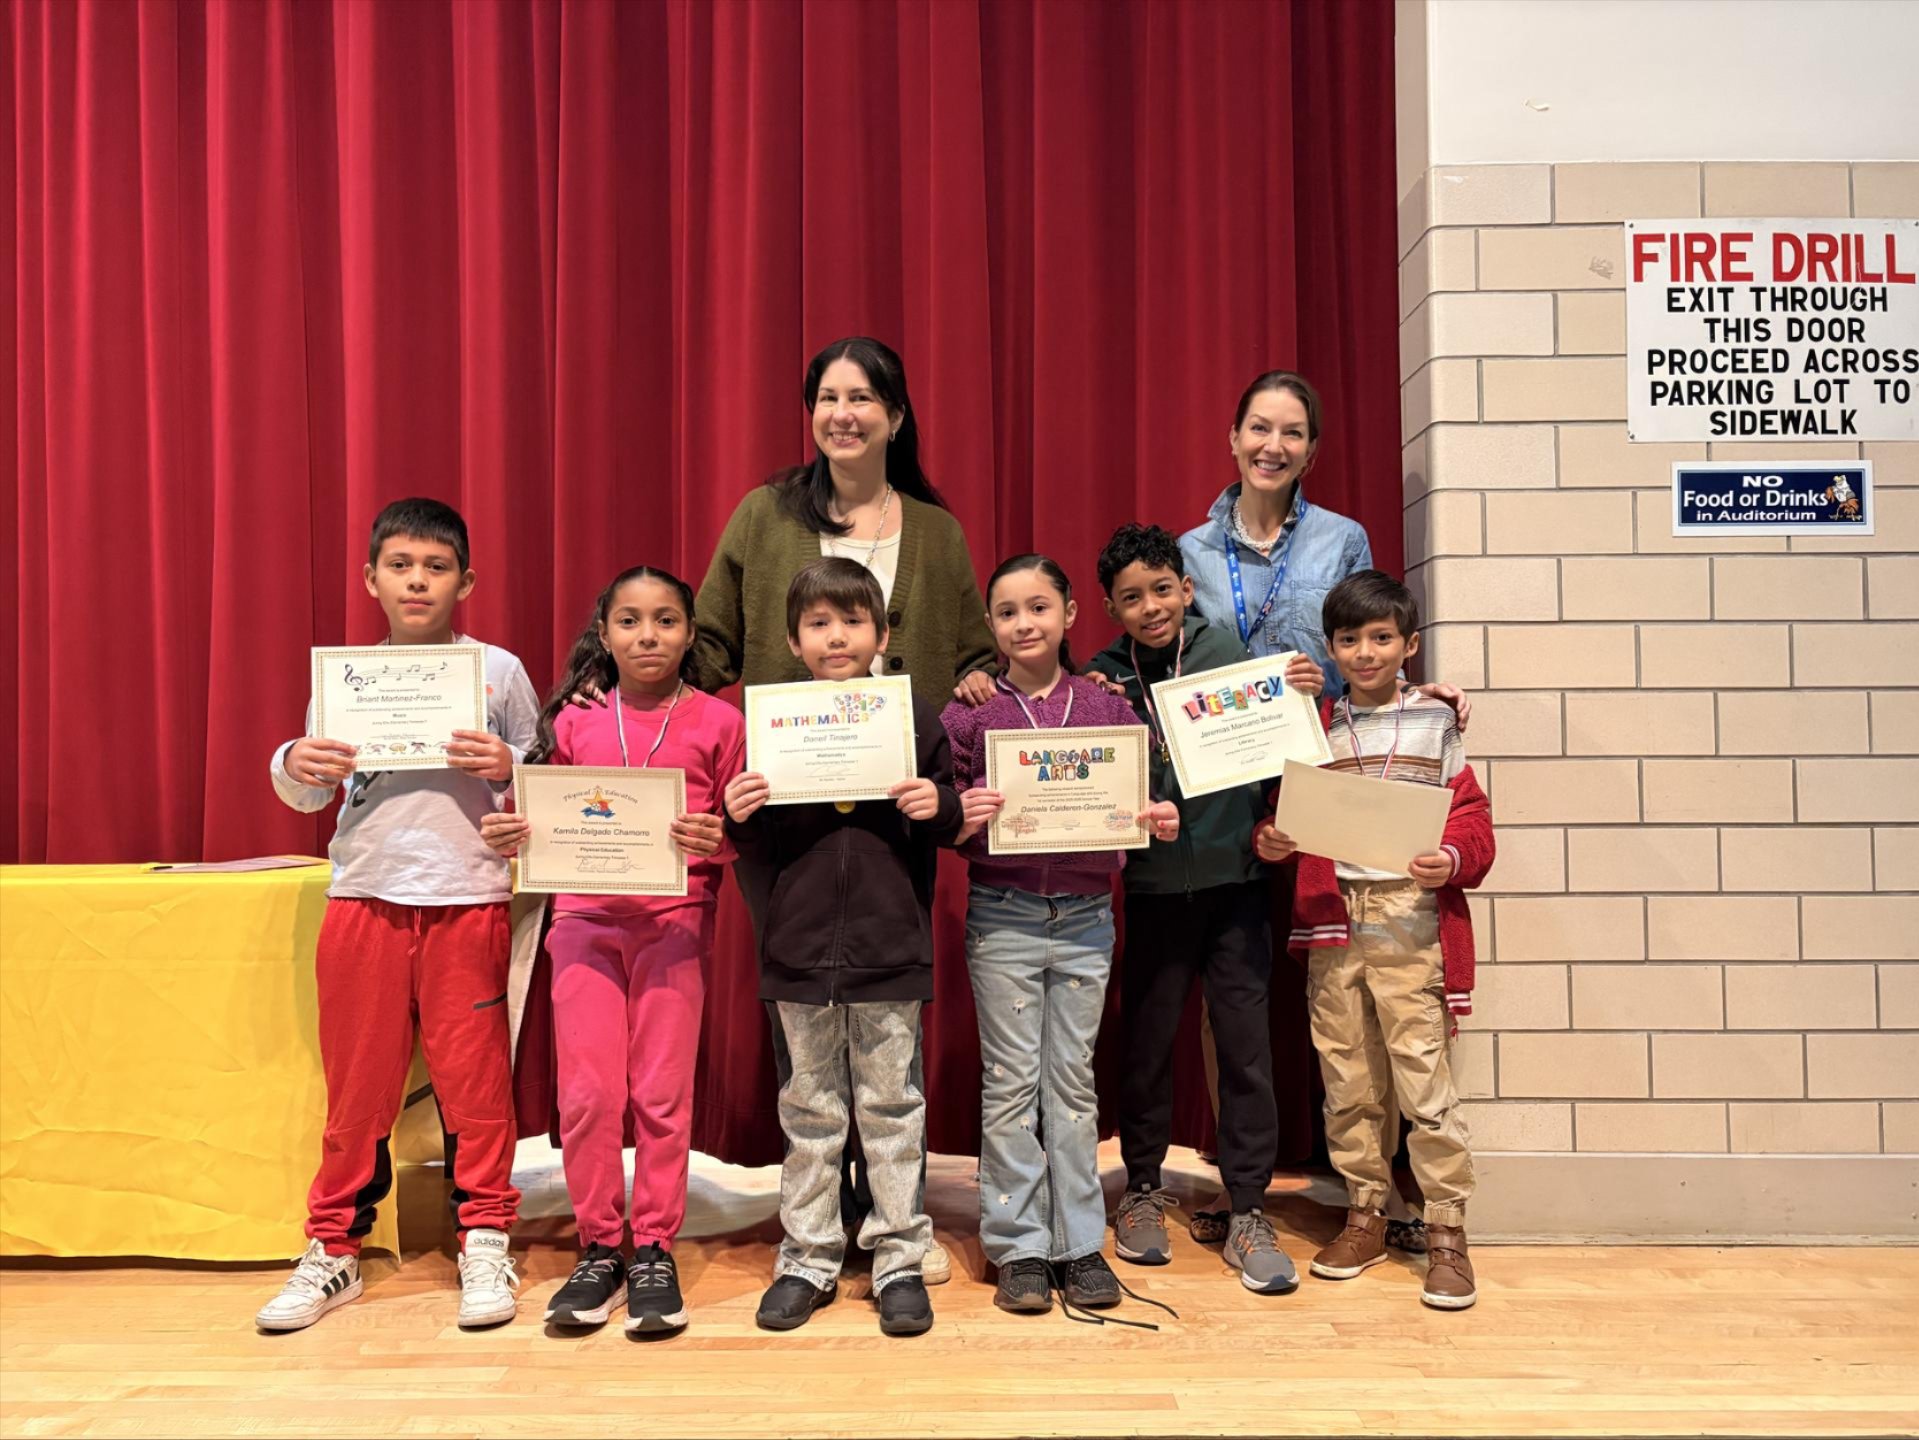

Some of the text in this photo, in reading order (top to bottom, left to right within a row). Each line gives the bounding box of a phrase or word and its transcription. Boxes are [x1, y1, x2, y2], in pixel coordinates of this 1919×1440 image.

[1632, 232, 1917, 284] FIRE DRILL
[1667, 286, 1888, 313] EXIT THROUGH
[1703, 317, 1866, 343] THIS DOOR
[1647, 348, 1919, 375] PROCEED ACROSS
[1650, 378, 1911, 406] PARKING LOT TO
[1709, 409, 1858, 436] SIDEWALK
[1742, 475, 1784, 488] NO
[1683, 489, 1829, 508] Food or Drinks
[1696, 509, 1817, 522] in Auditorium
[771, 711, 870, 729] MATHEMATICS
[1037, 763, 1089, 781] ARTS
[1020, 803, 1117, 813] Daniela Calderon-Gonzalez
[553, 827, 650, 837] Kamila Delgado Chamorro
[473, 1237, 505, 1247] adidas
